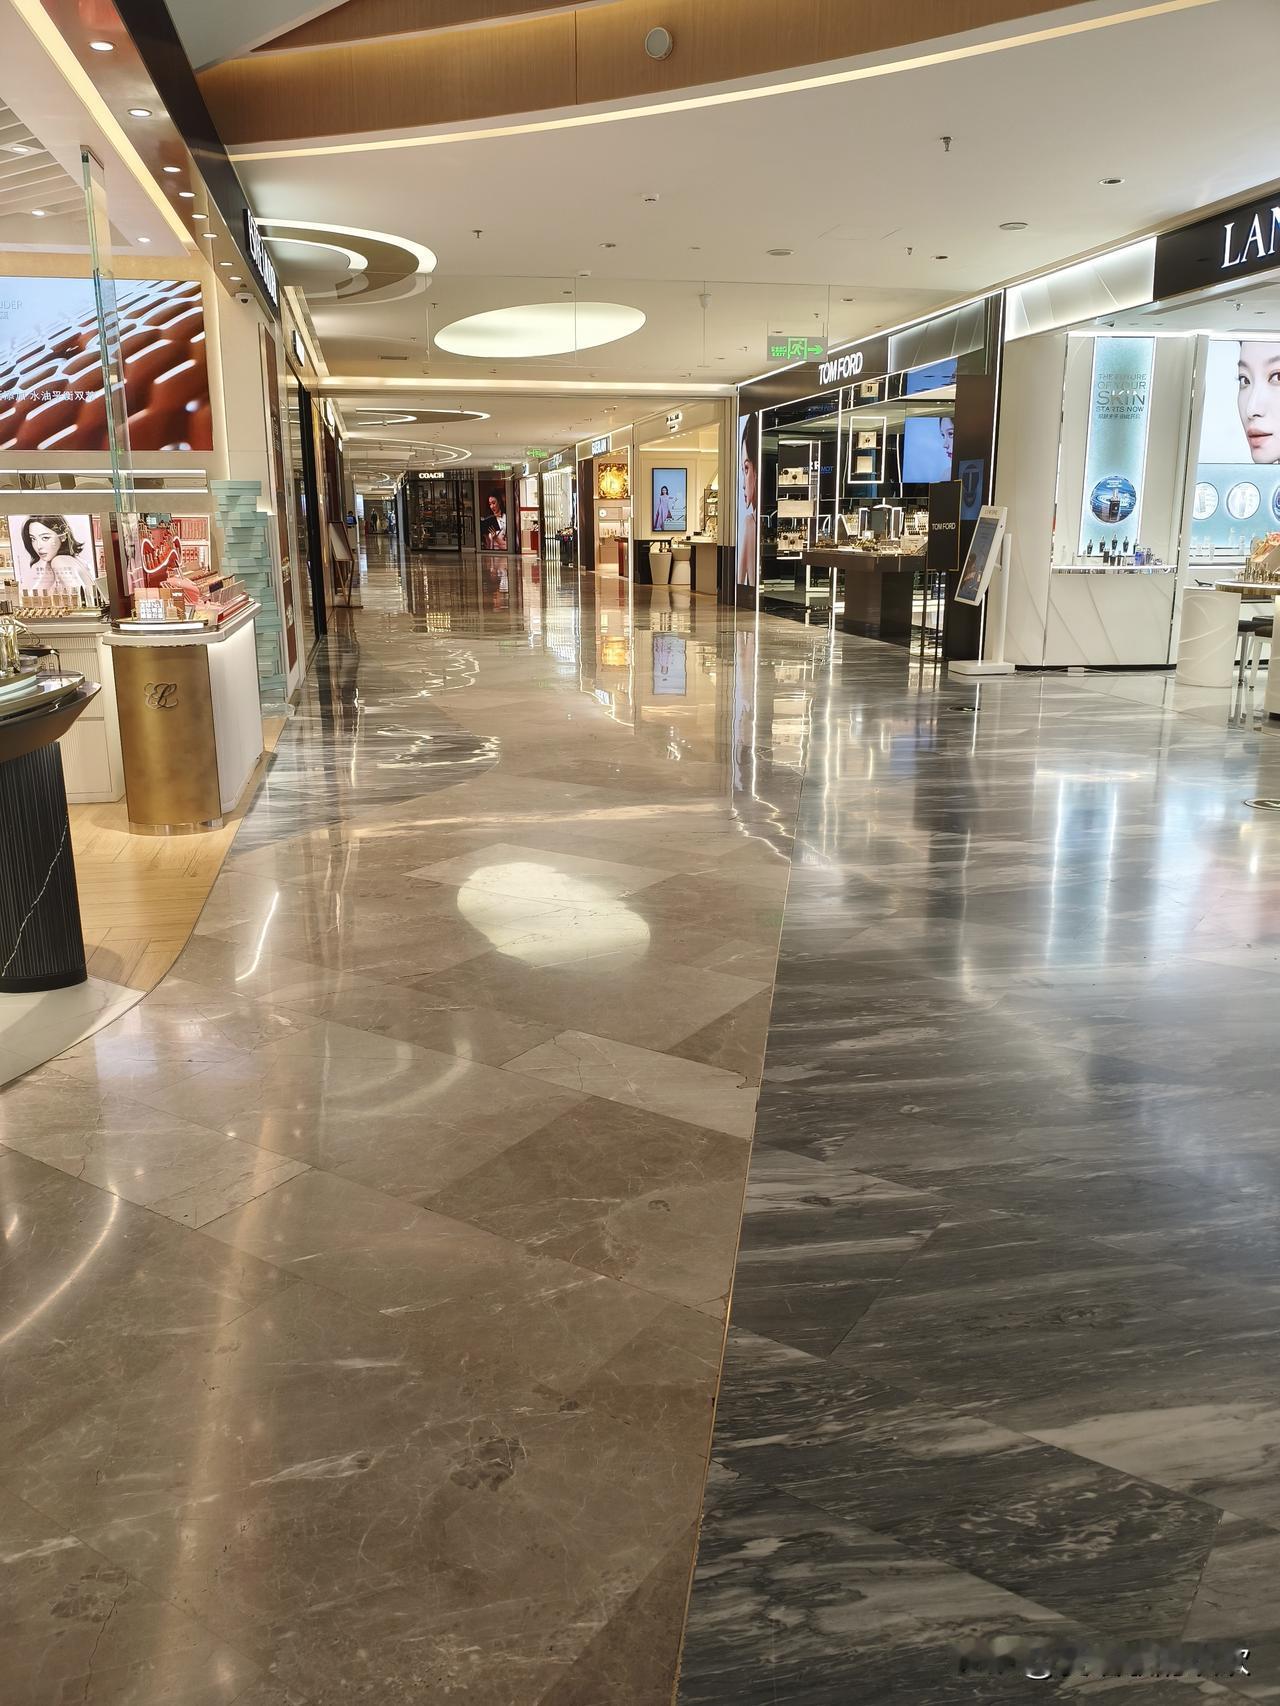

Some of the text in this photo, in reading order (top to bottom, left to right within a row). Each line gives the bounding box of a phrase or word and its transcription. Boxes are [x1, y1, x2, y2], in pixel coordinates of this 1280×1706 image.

[818, 351, 863, 385] TOM FORD
[1115, 381, 1147, 390] YOUR
[1096, 390, 1145, 405] SKIN
[1095, 405, 1125, 413] STARTS
[931, 522, 956, 531] TOM FORD
